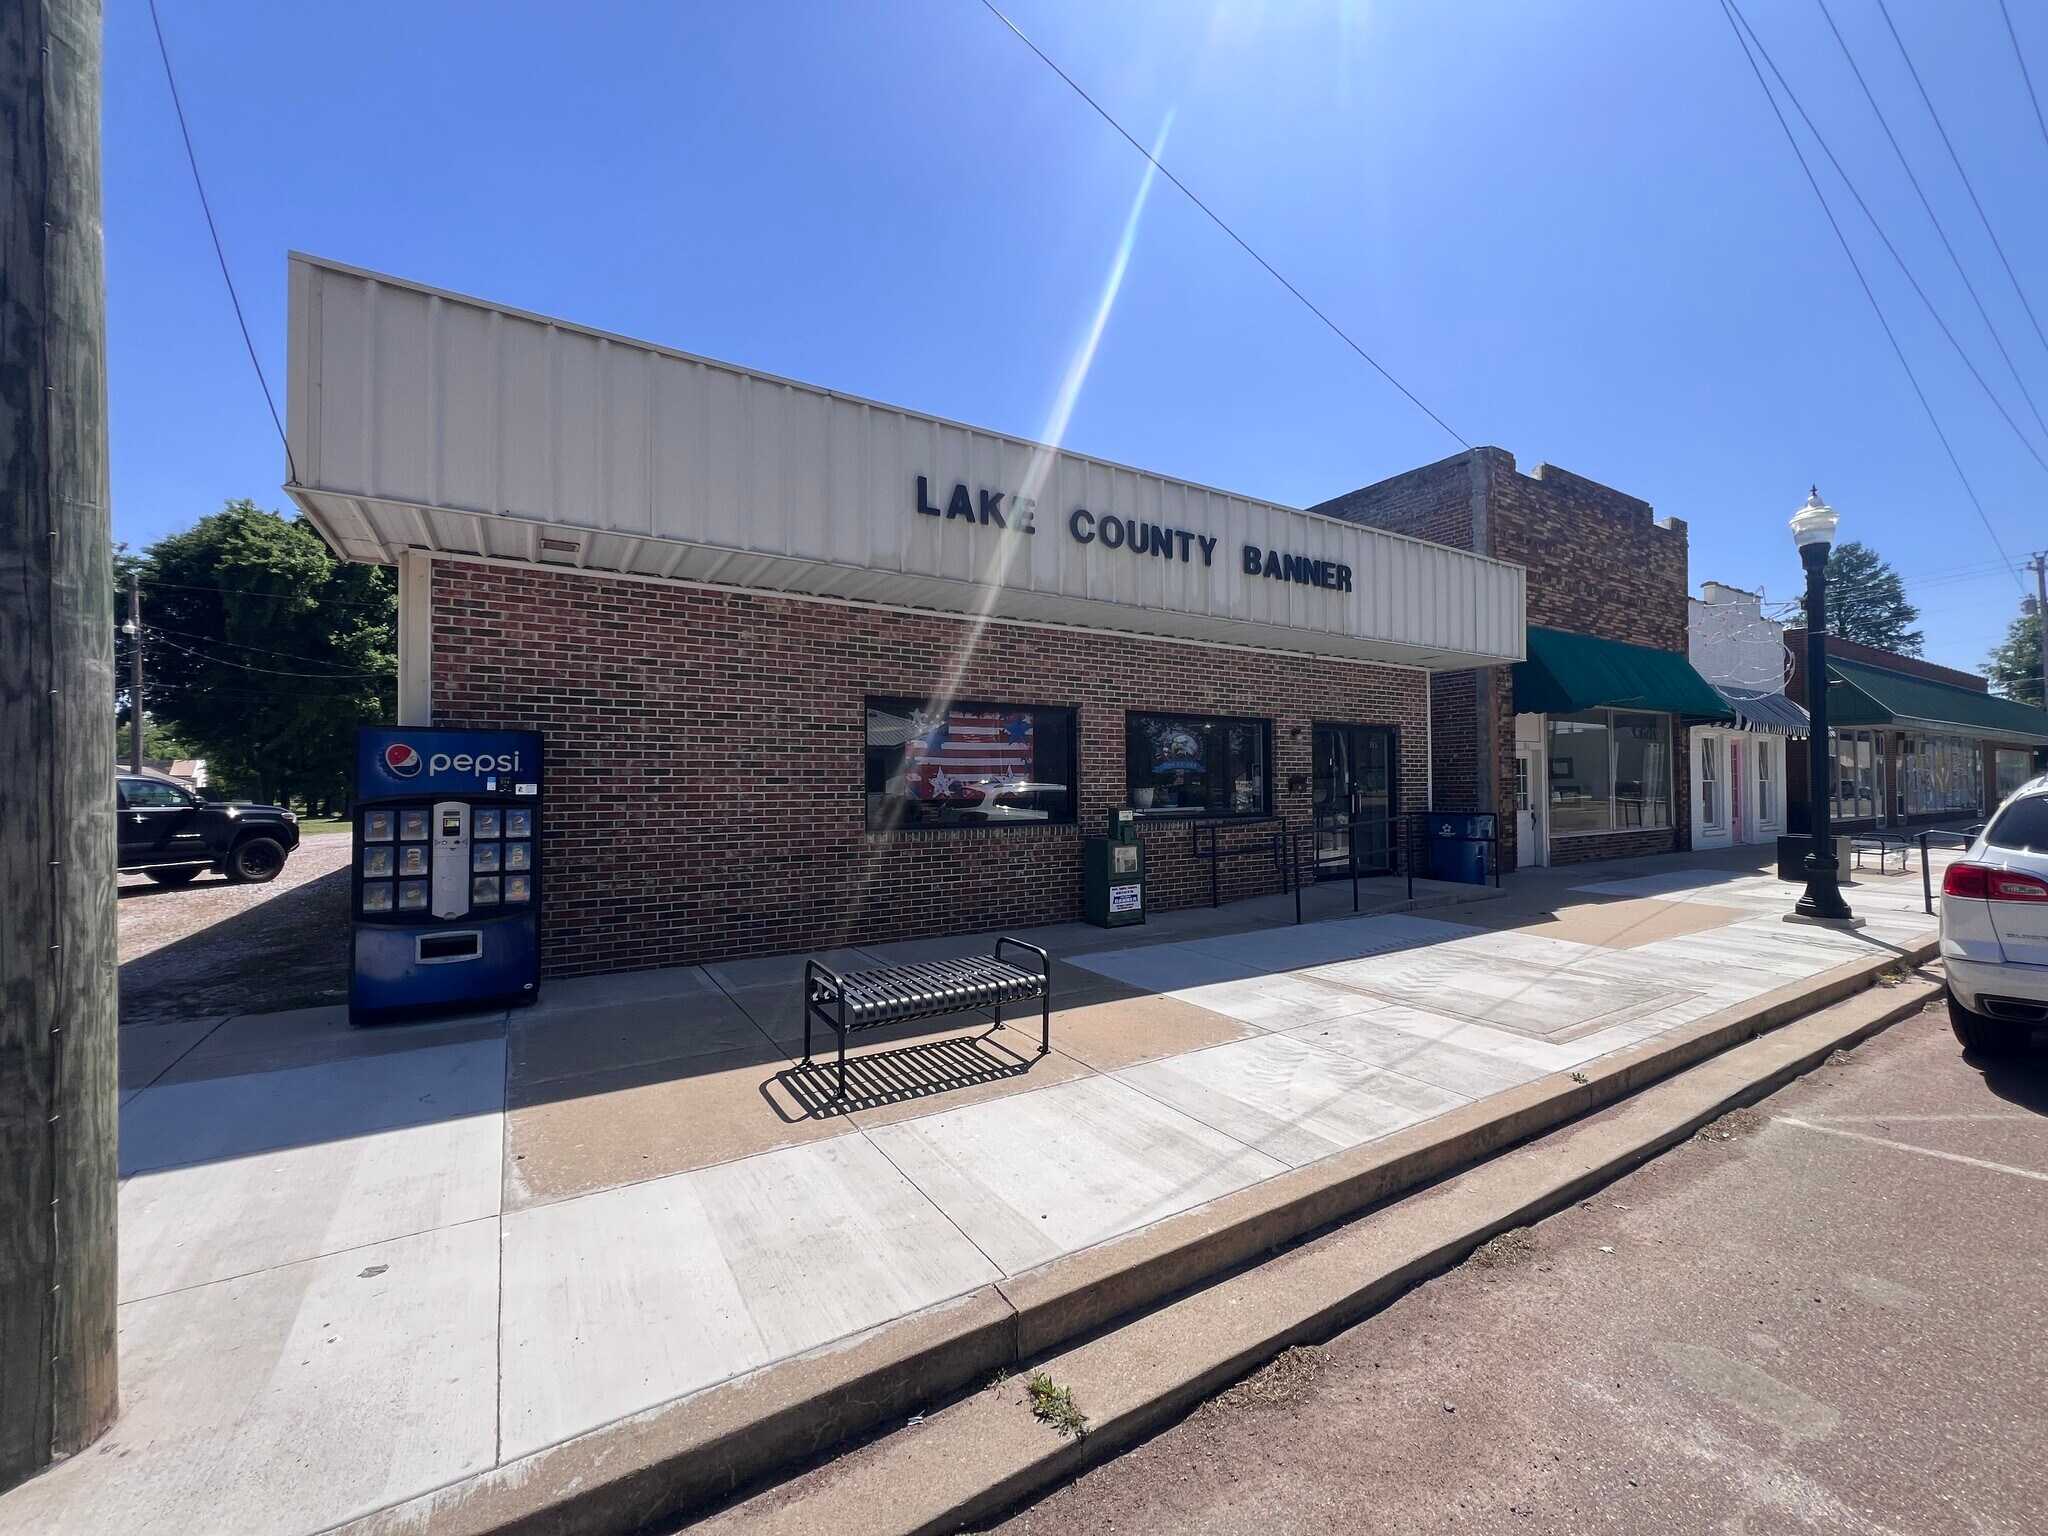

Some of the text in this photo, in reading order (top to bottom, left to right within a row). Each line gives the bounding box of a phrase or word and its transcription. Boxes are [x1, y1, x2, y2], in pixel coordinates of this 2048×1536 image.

[917, 475, 1353, 593] LAKE COUNTY BANNER
[429, 750, 520, 777] pepsi
